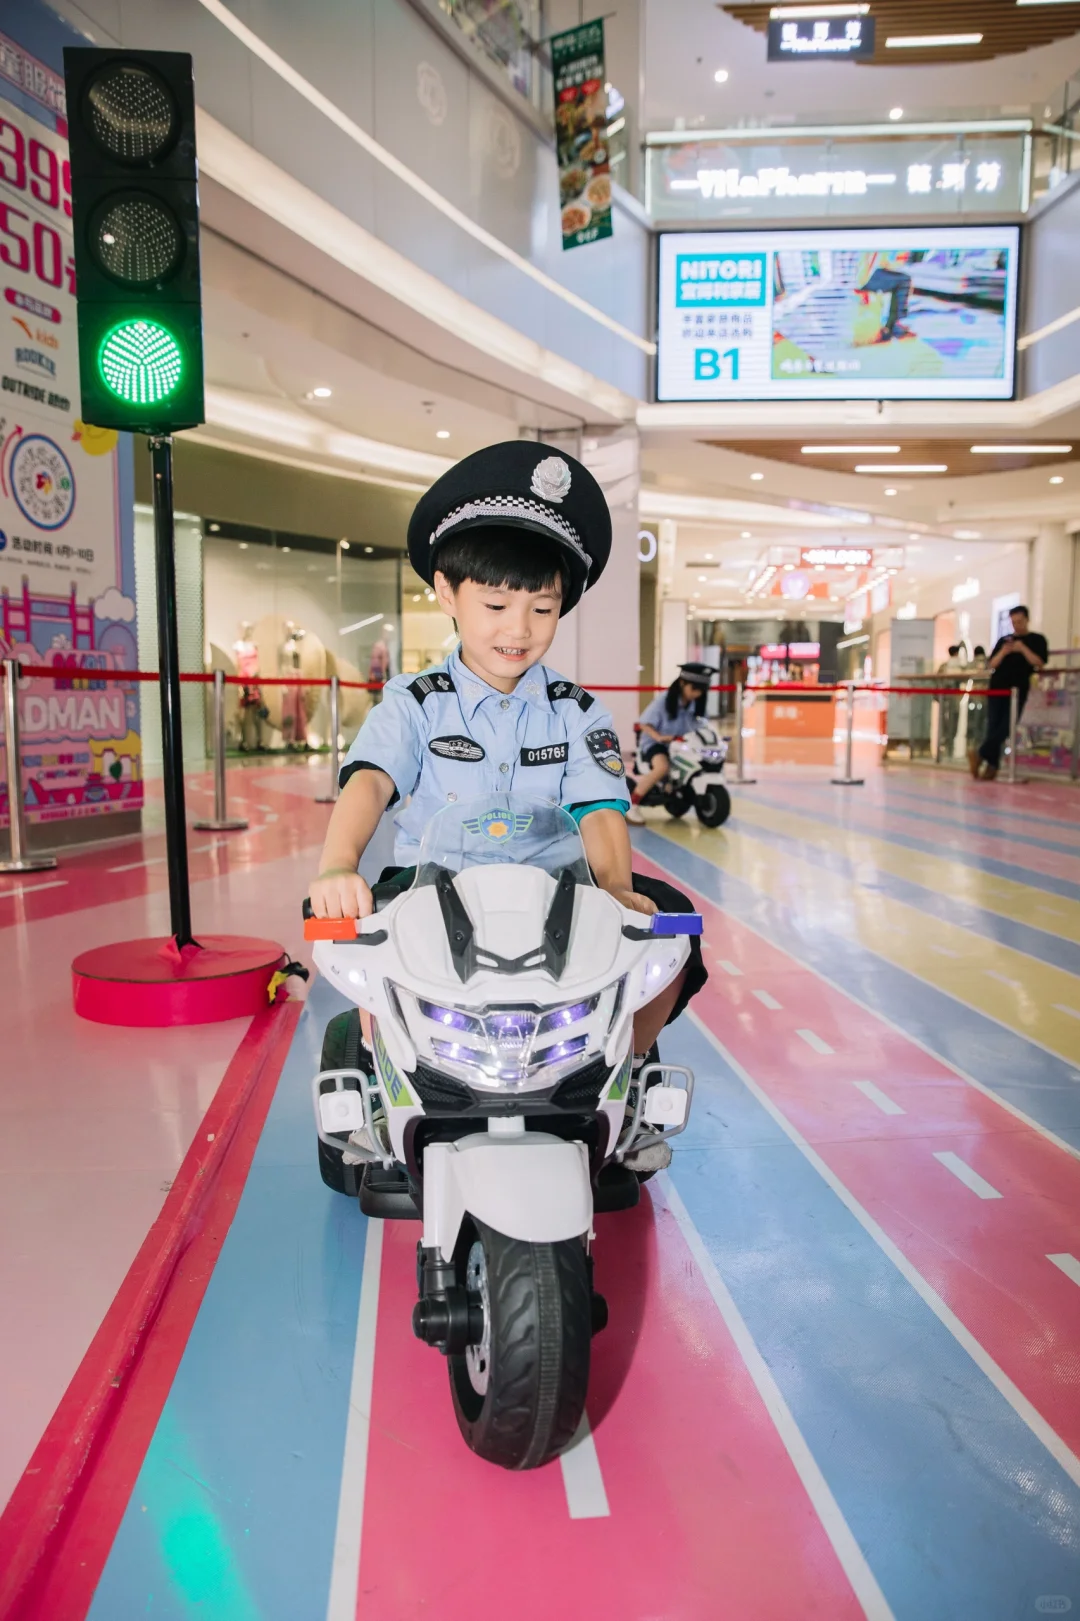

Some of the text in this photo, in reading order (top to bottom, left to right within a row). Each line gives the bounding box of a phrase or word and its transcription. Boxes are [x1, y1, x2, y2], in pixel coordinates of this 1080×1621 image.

[681, 259, 762, 280] NITORI
[694, 348, 740, 380] B1
[527, 746, 565, 762] 015765
